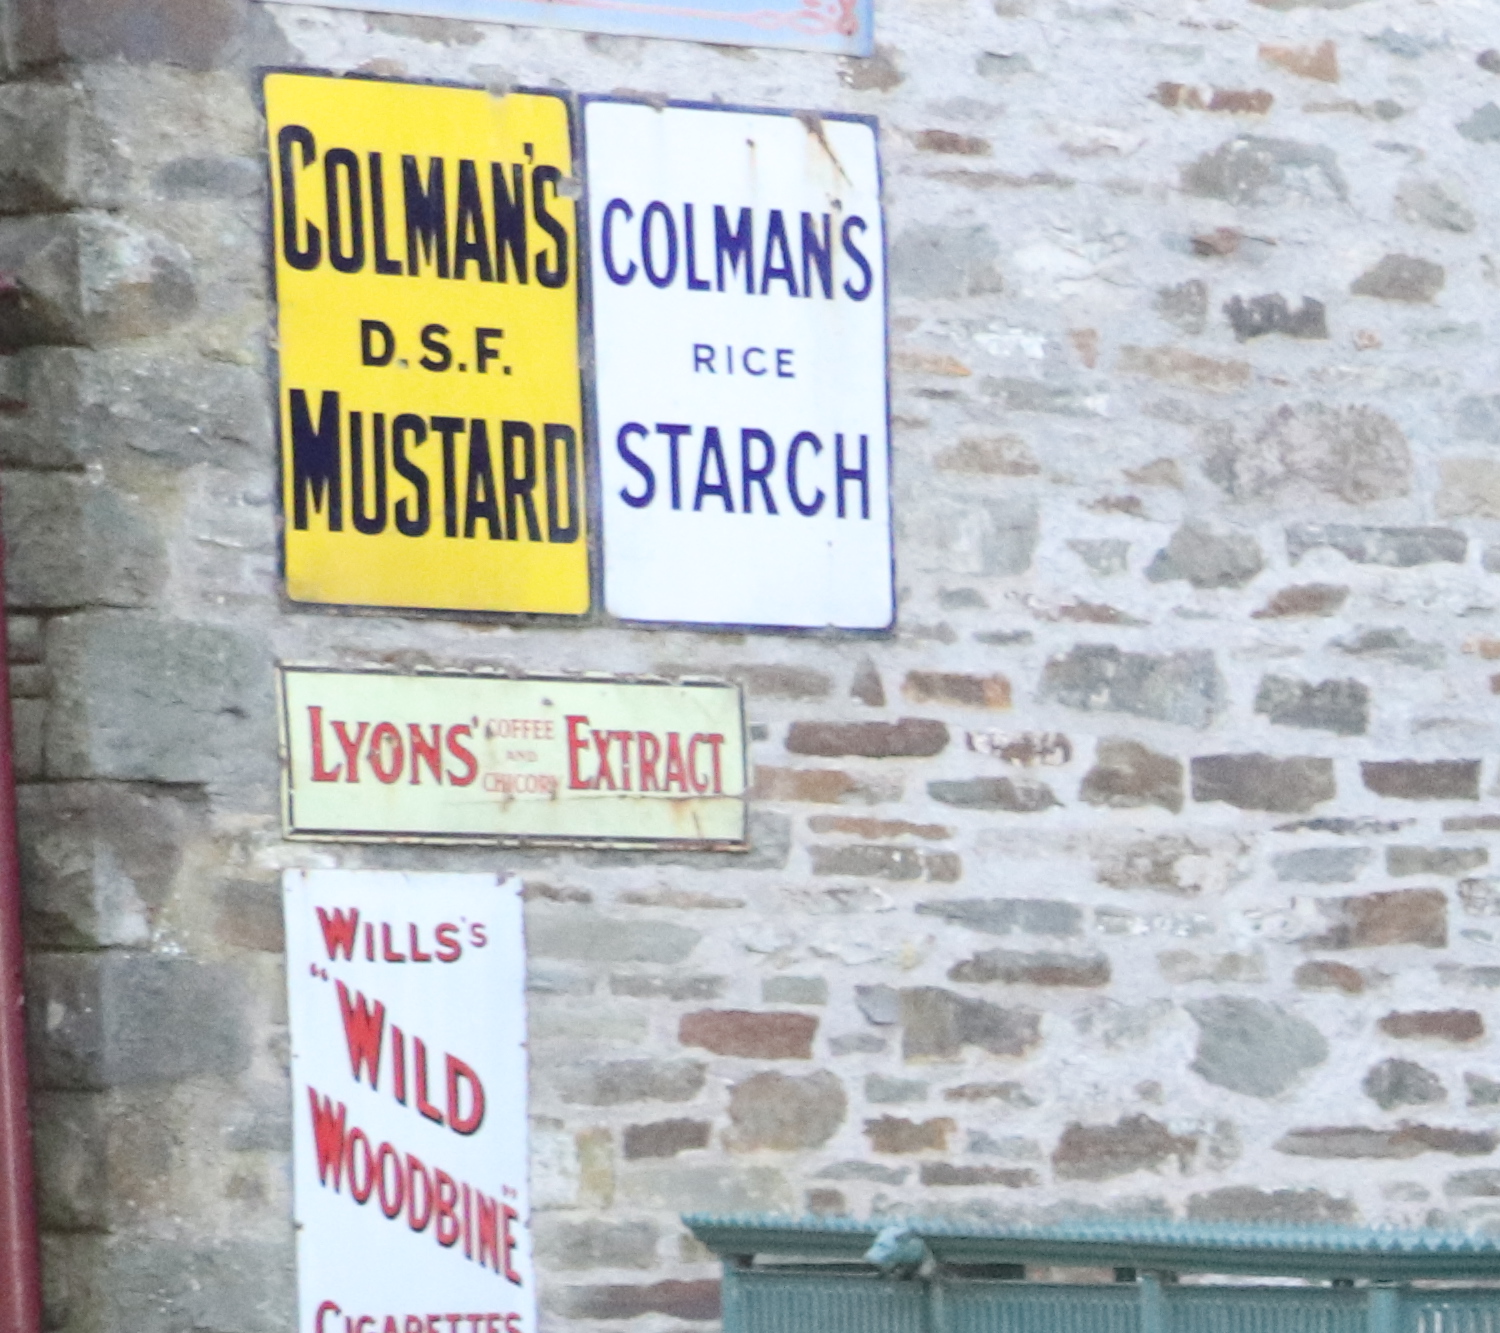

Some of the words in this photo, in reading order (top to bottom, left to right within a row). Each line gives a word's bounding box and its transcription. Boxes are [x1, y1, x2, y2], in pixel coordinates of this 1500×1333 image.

[276, 124, 569, 290] COLMAN'S
[600, 197, 874, 302] COLMAN'S
[359, 319, 513, 376] D.S.F.
[692, 343, 796, 379] RICE
[288, 387, 580, 545] MUSTARD
[615, 421, 872, 520] STARCH
[307, 706, 480, 788] LYONS'
[564, 714, 726, 796] EXTRACT
[315, 905, 488, 963] WILLS'S
